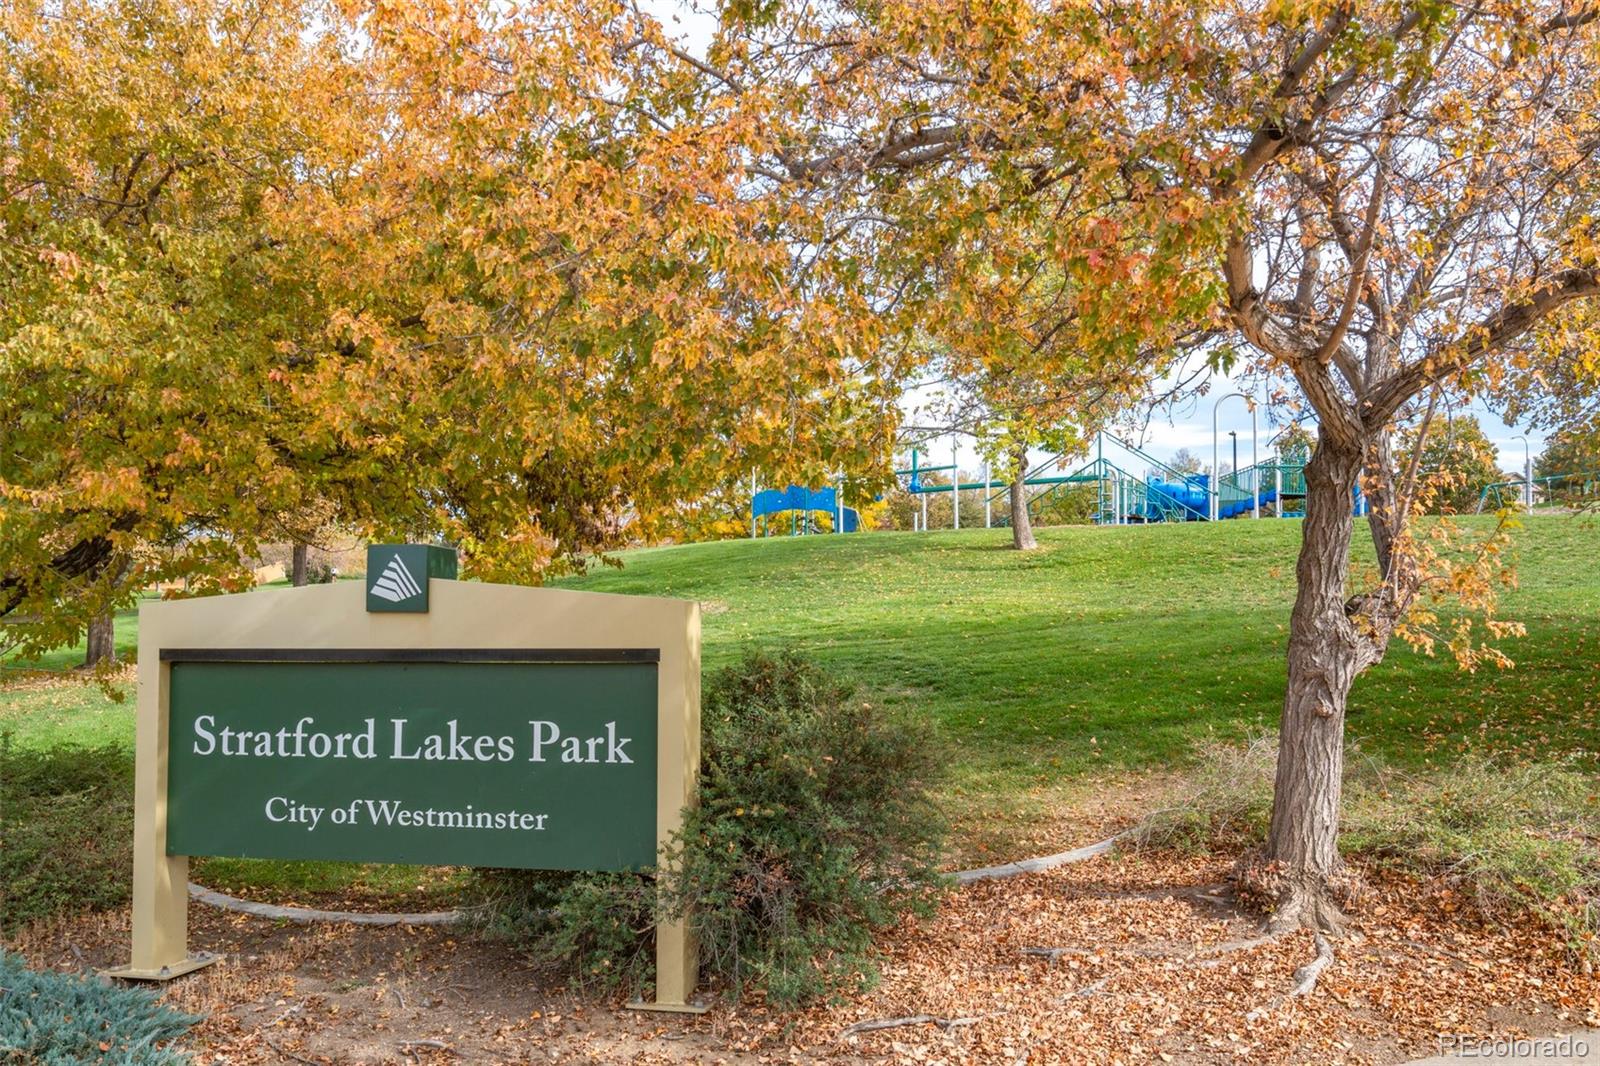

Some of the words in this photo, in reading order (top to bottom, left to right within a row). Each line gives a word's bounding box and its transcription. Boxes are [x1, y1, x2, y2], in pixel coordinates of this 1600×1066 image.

[193, 715, 378, 759] Stratford
[389, 719, 515, 762] Lakes
[528, 720, 634, 764] Park
[265, 796, 325, 832] City
[330, 799, 363, 824] of
[364, 799, 549, 830] Westminster
